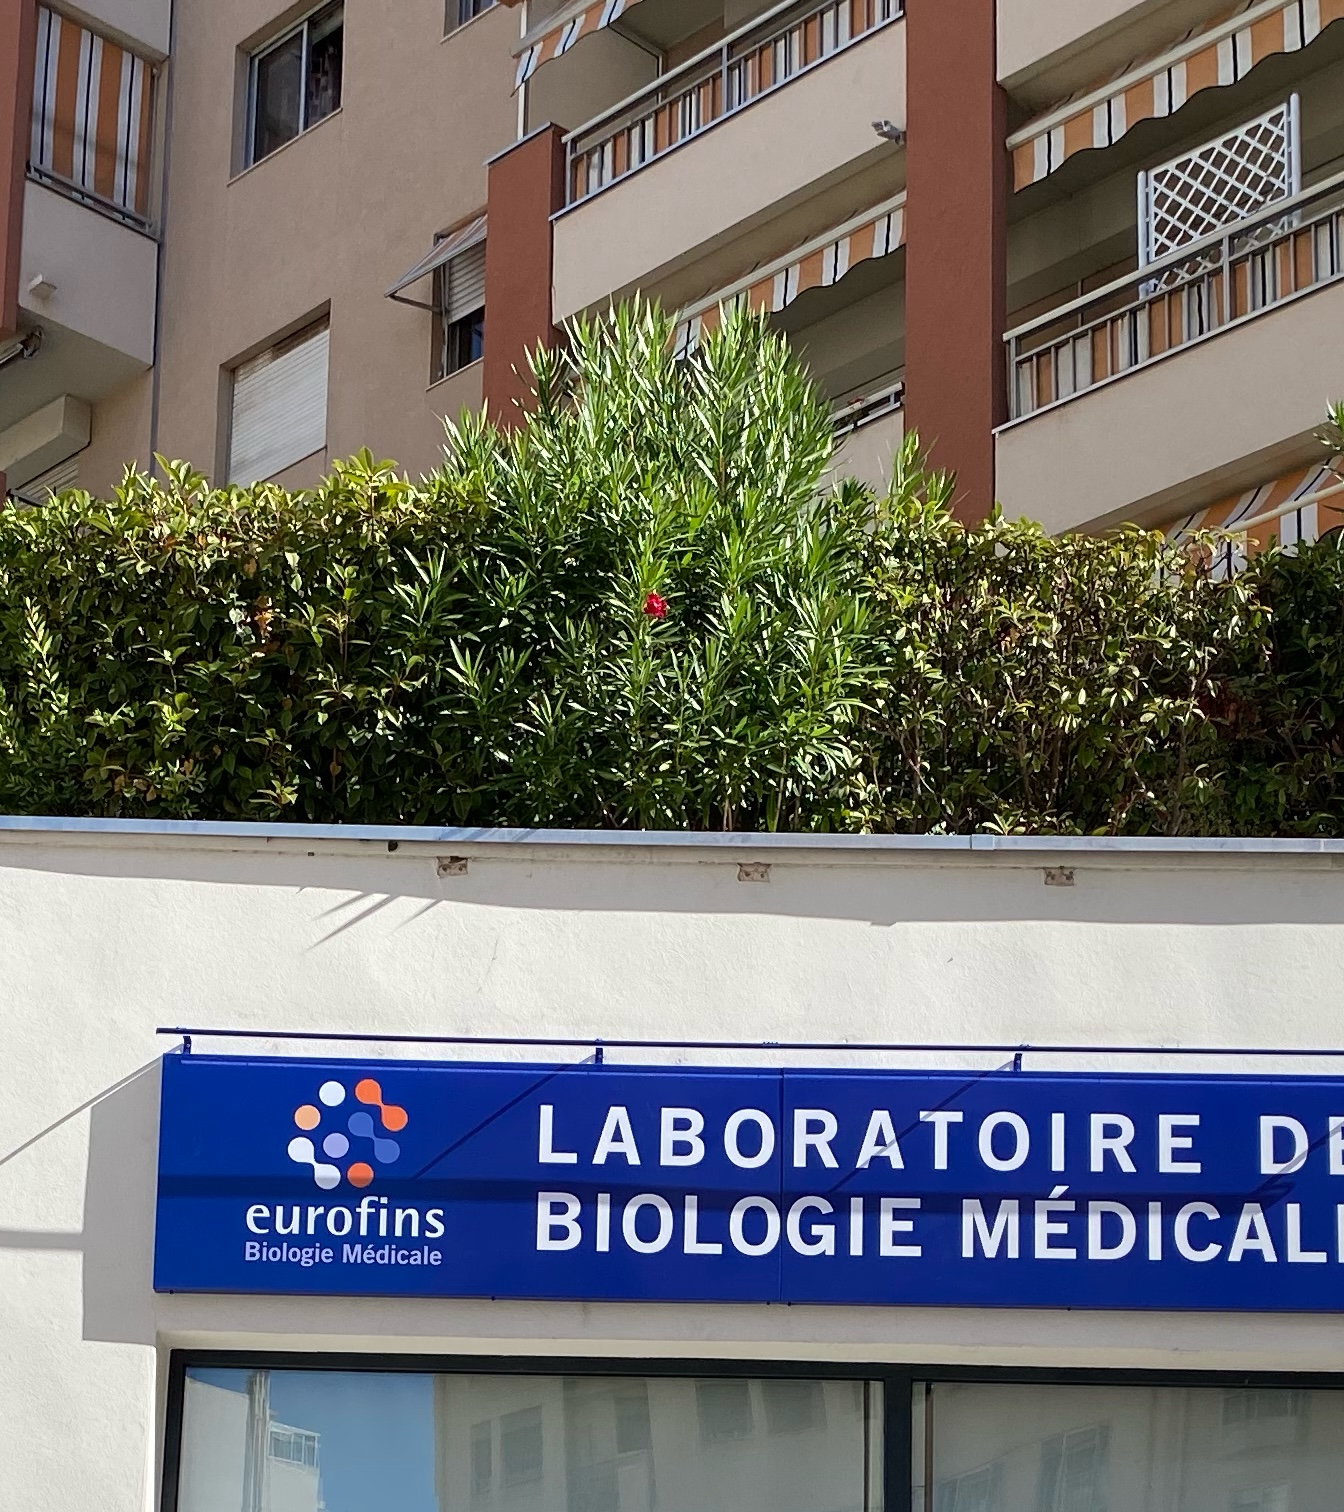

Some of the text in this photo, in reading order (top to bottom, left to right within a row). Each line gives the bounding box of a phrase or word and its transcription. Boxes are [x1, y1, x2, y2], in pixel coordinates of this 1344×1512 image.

[537, 1104, 1203, 1175] LABORATOIRE
[245, 1195, 446, 1239] eurofins
[535, 1191, 923, 1258] BIOLOGIE
[244, 1241, 443, 1268] Biologie Médicale
